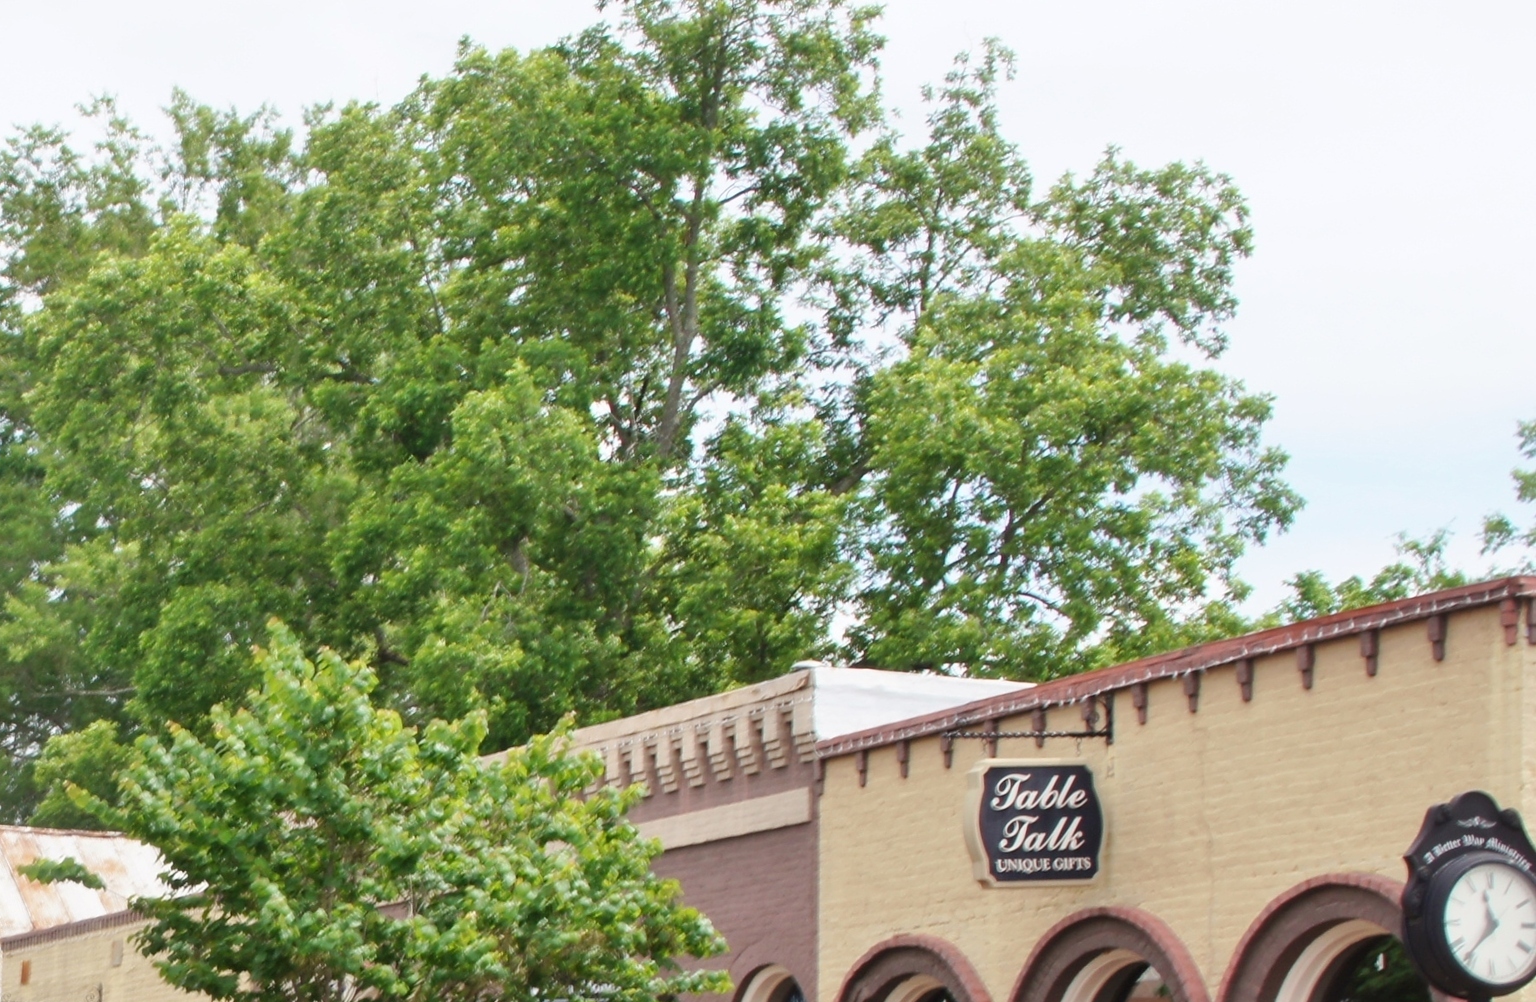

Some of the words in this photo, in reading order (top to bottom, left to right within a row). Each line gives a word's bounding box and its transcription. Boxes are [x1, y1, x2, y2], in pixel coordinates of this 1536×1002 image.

[990, 773, 1088, 811] Table
[998, 815, 1086, 853] Talk
[1423, 851, 1435, 865] A
[1432, 838, 1462, 857] Better
[1463, 834, 1485, 848] Way
[1485, 837, 1533, 872] Ministries
[996, 858, 1051, 874] UNIQUE
[1052, 857, 1092, 871] GIFTS
